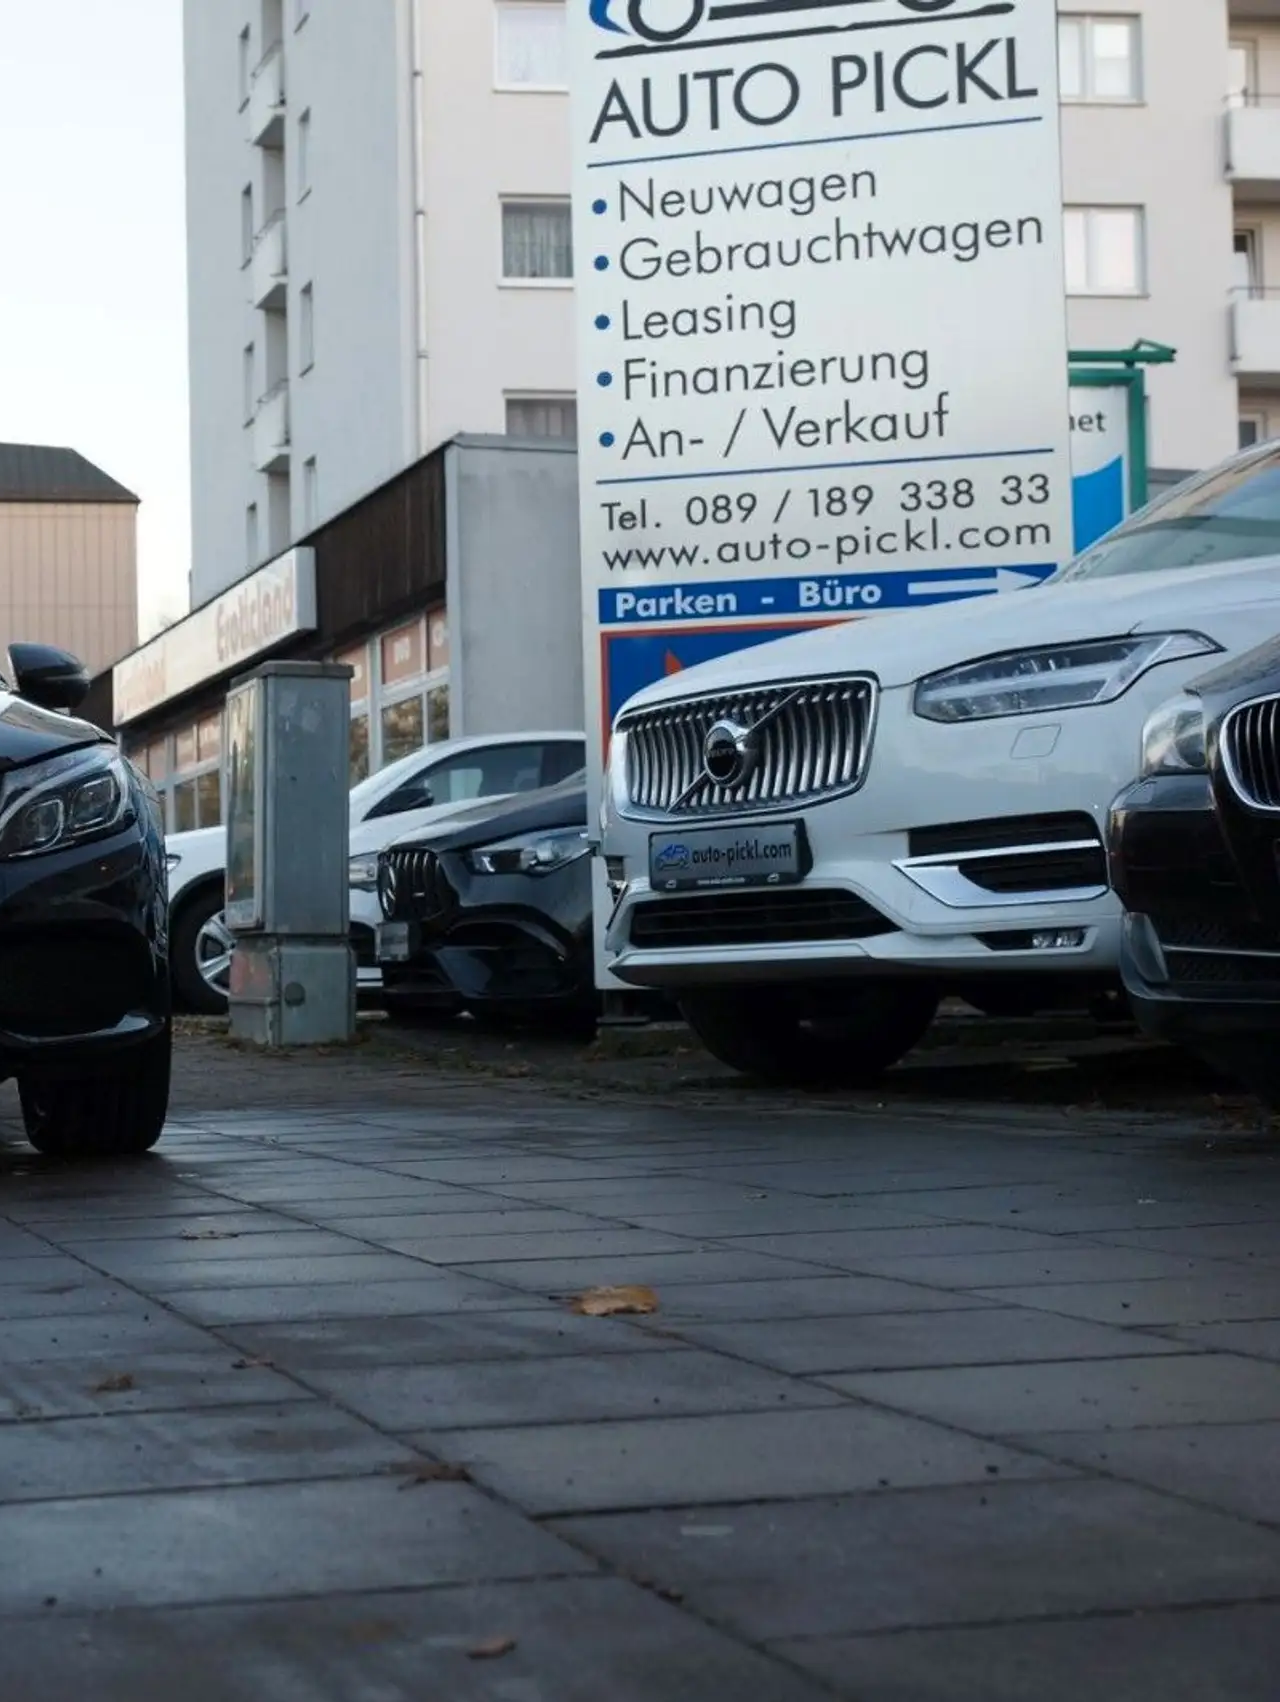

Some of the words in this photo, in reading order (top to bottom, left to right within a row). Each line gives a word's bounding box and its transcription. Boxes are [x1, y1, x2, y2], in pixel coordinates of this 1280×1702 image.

[589, 62, 800, 143] AUTO
[831, 37, 1038, 116] PICKL
[620, 170, 876, 221] Neuwagen
[620, 216, 1043, 281] Gebrauchtwagen
[622, 294, 796, 340] Leasing
[624, 350, 929, 400] Finanzierung
[622, 417, 704, 461] An-
[762, 391, 949, 448] Verkauf
[601, 499, 661, 531] Tel.
[685, 493, 757, 526] 089
[809, 485, 874, 518] 189
[901, 479, 975, 512] 338
[1001, 474, 1050, 506] 33
[602, 517, 1051, 571] www.auto-pickl.com
[615, 587, 737, 618] Parken
[799, 580, 882, 608] Büro
[692, 840, 792, 867] auto-pickl.com
